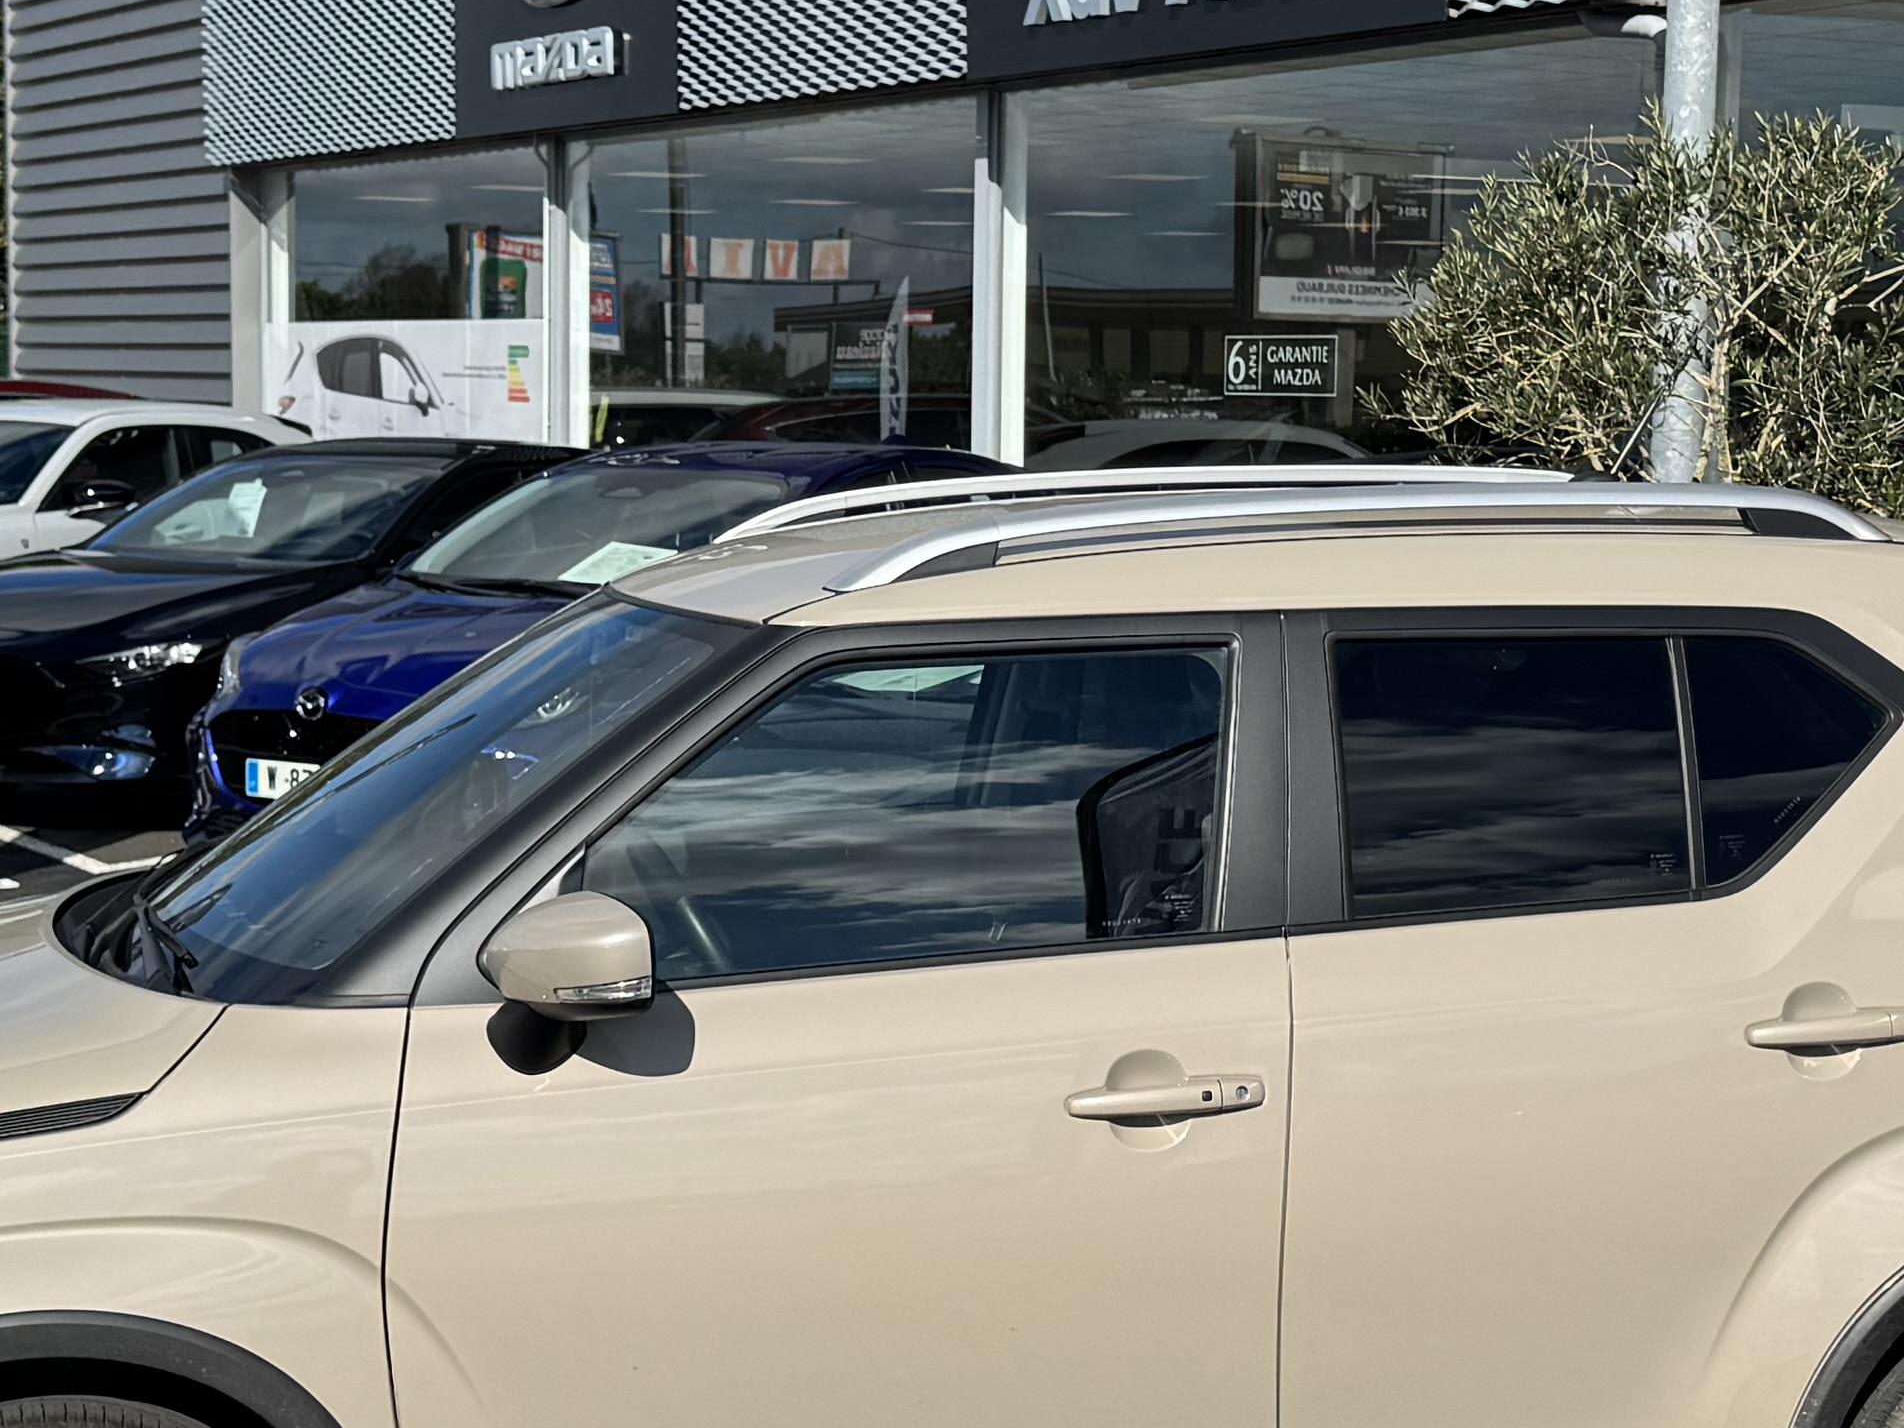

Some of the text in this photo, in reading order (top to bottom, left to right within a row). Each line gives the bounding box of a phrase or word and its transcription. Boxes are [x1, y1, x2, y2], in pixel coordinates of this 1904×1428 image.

[1228, 340, 1257, 384] 6 ANS
[1267, 346, 1329, 363] GARANTIE
[1273, 369, 1322, 386] MAZDA
